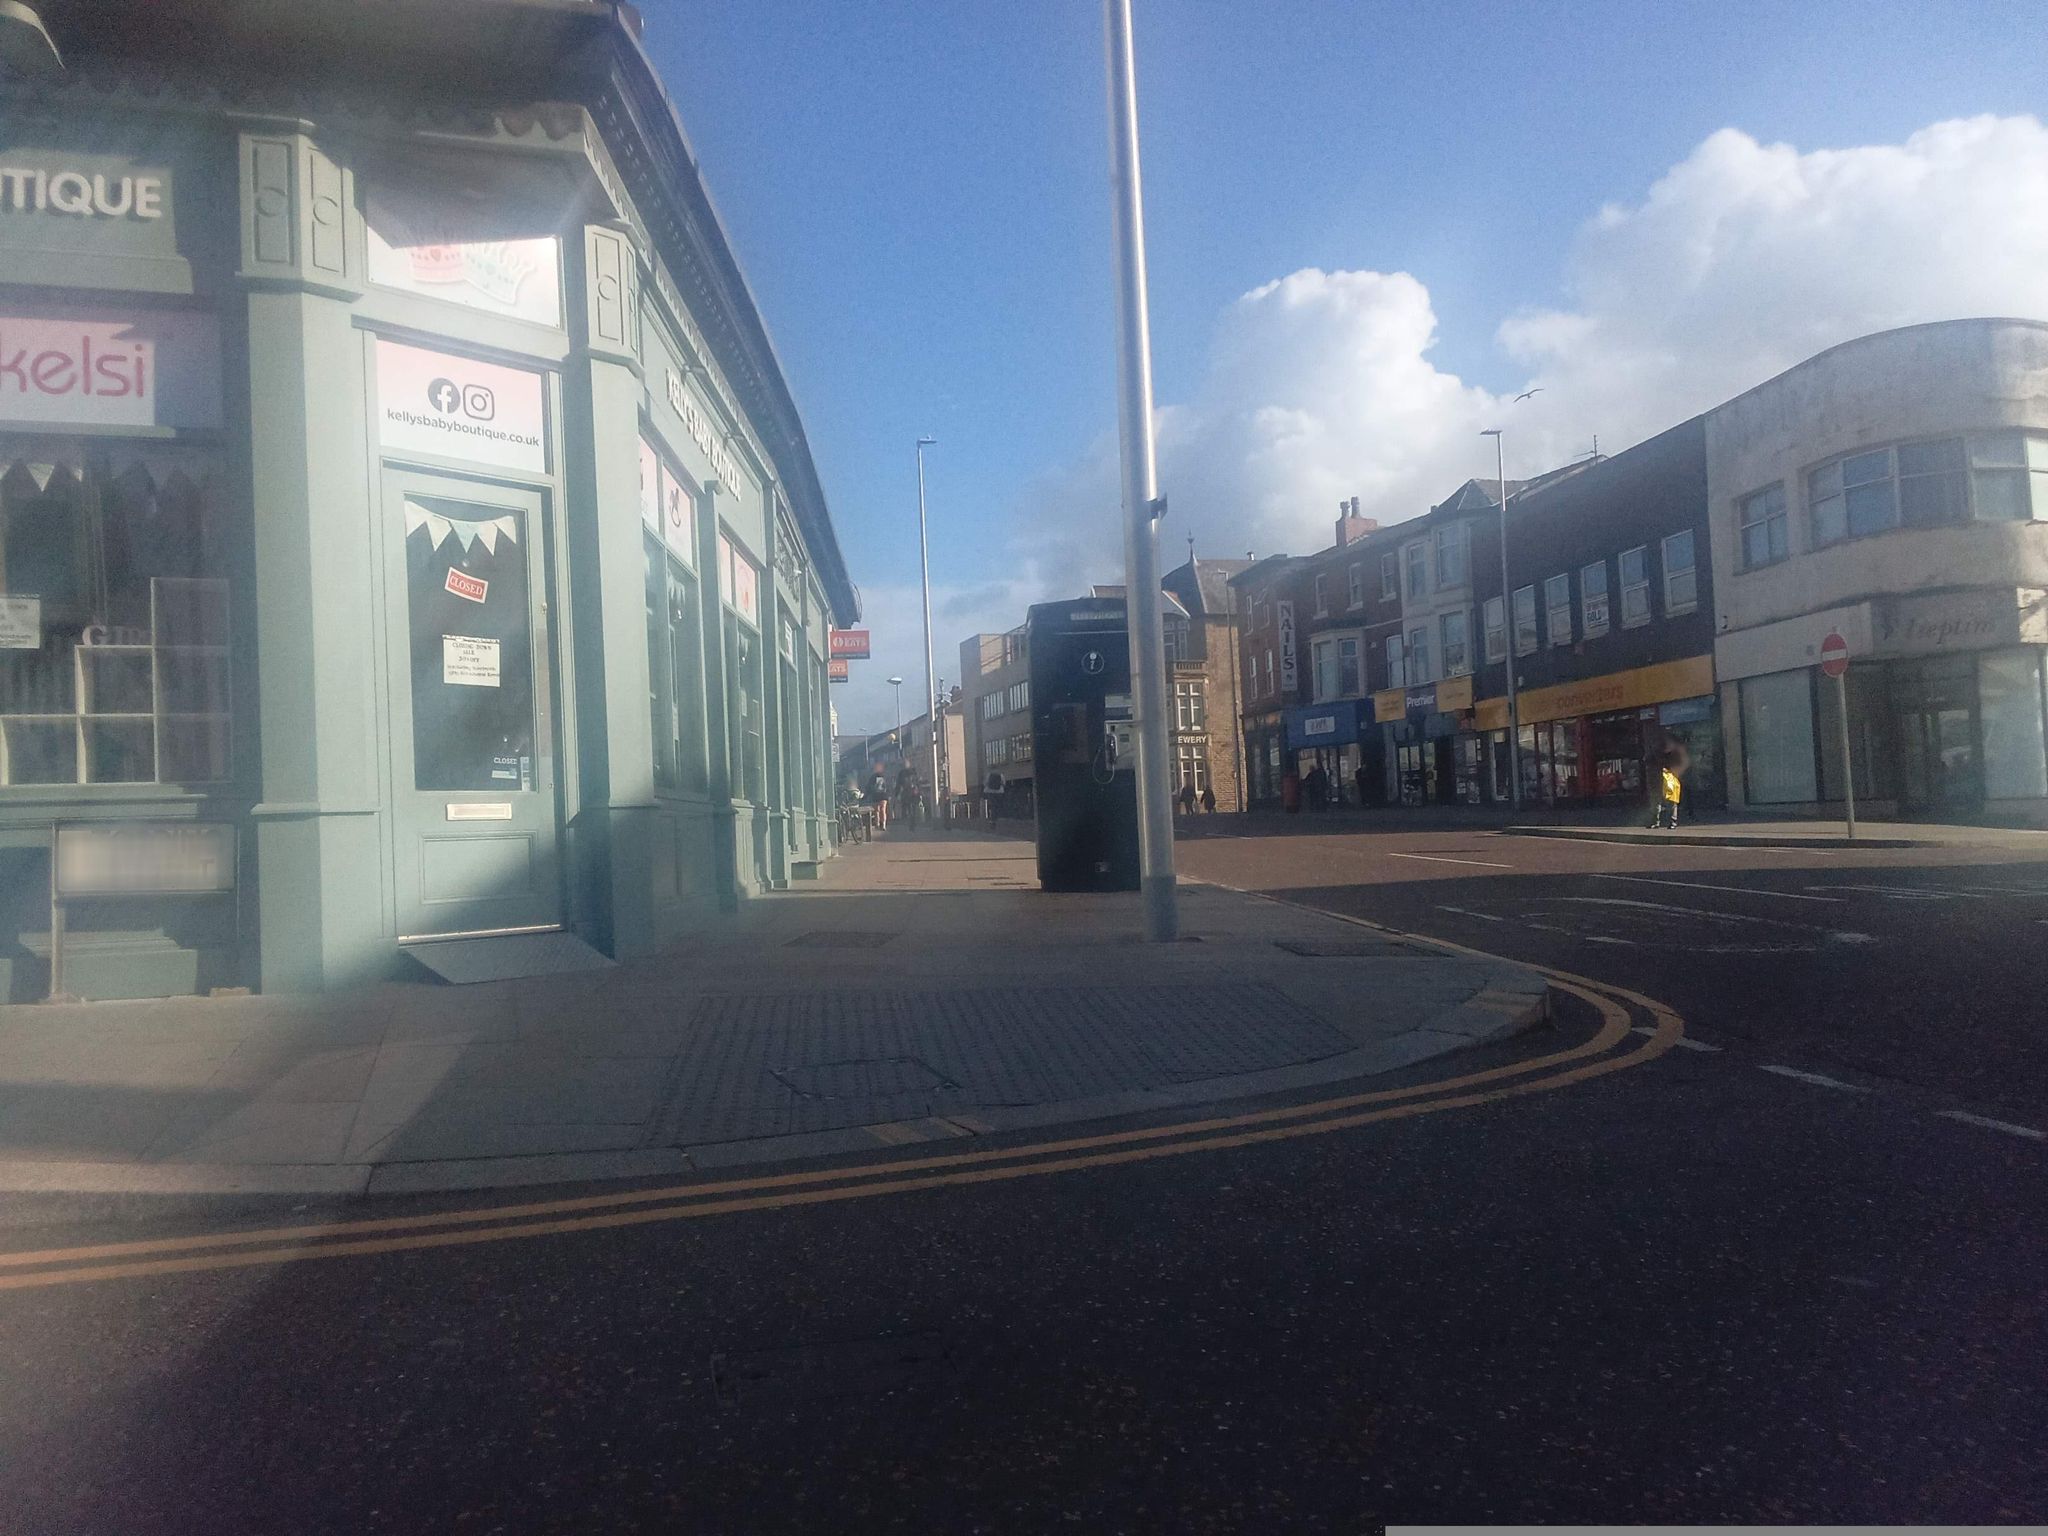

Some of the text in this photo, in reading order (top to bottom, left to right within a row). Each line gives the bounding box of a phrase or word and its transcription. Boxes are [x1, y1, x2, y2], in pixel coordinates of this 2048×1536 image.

[0, 167, 163, 218] TIQUE
[0, 335, 145, 398] kelsi
[387, 408, 540, 447] kellysbabyboutique.co.uk
[449, 575, 484, 596] CLOSED
[1280, 605, 1295, 671] NAILS
[1406, 694, 1436, 709] Premier
